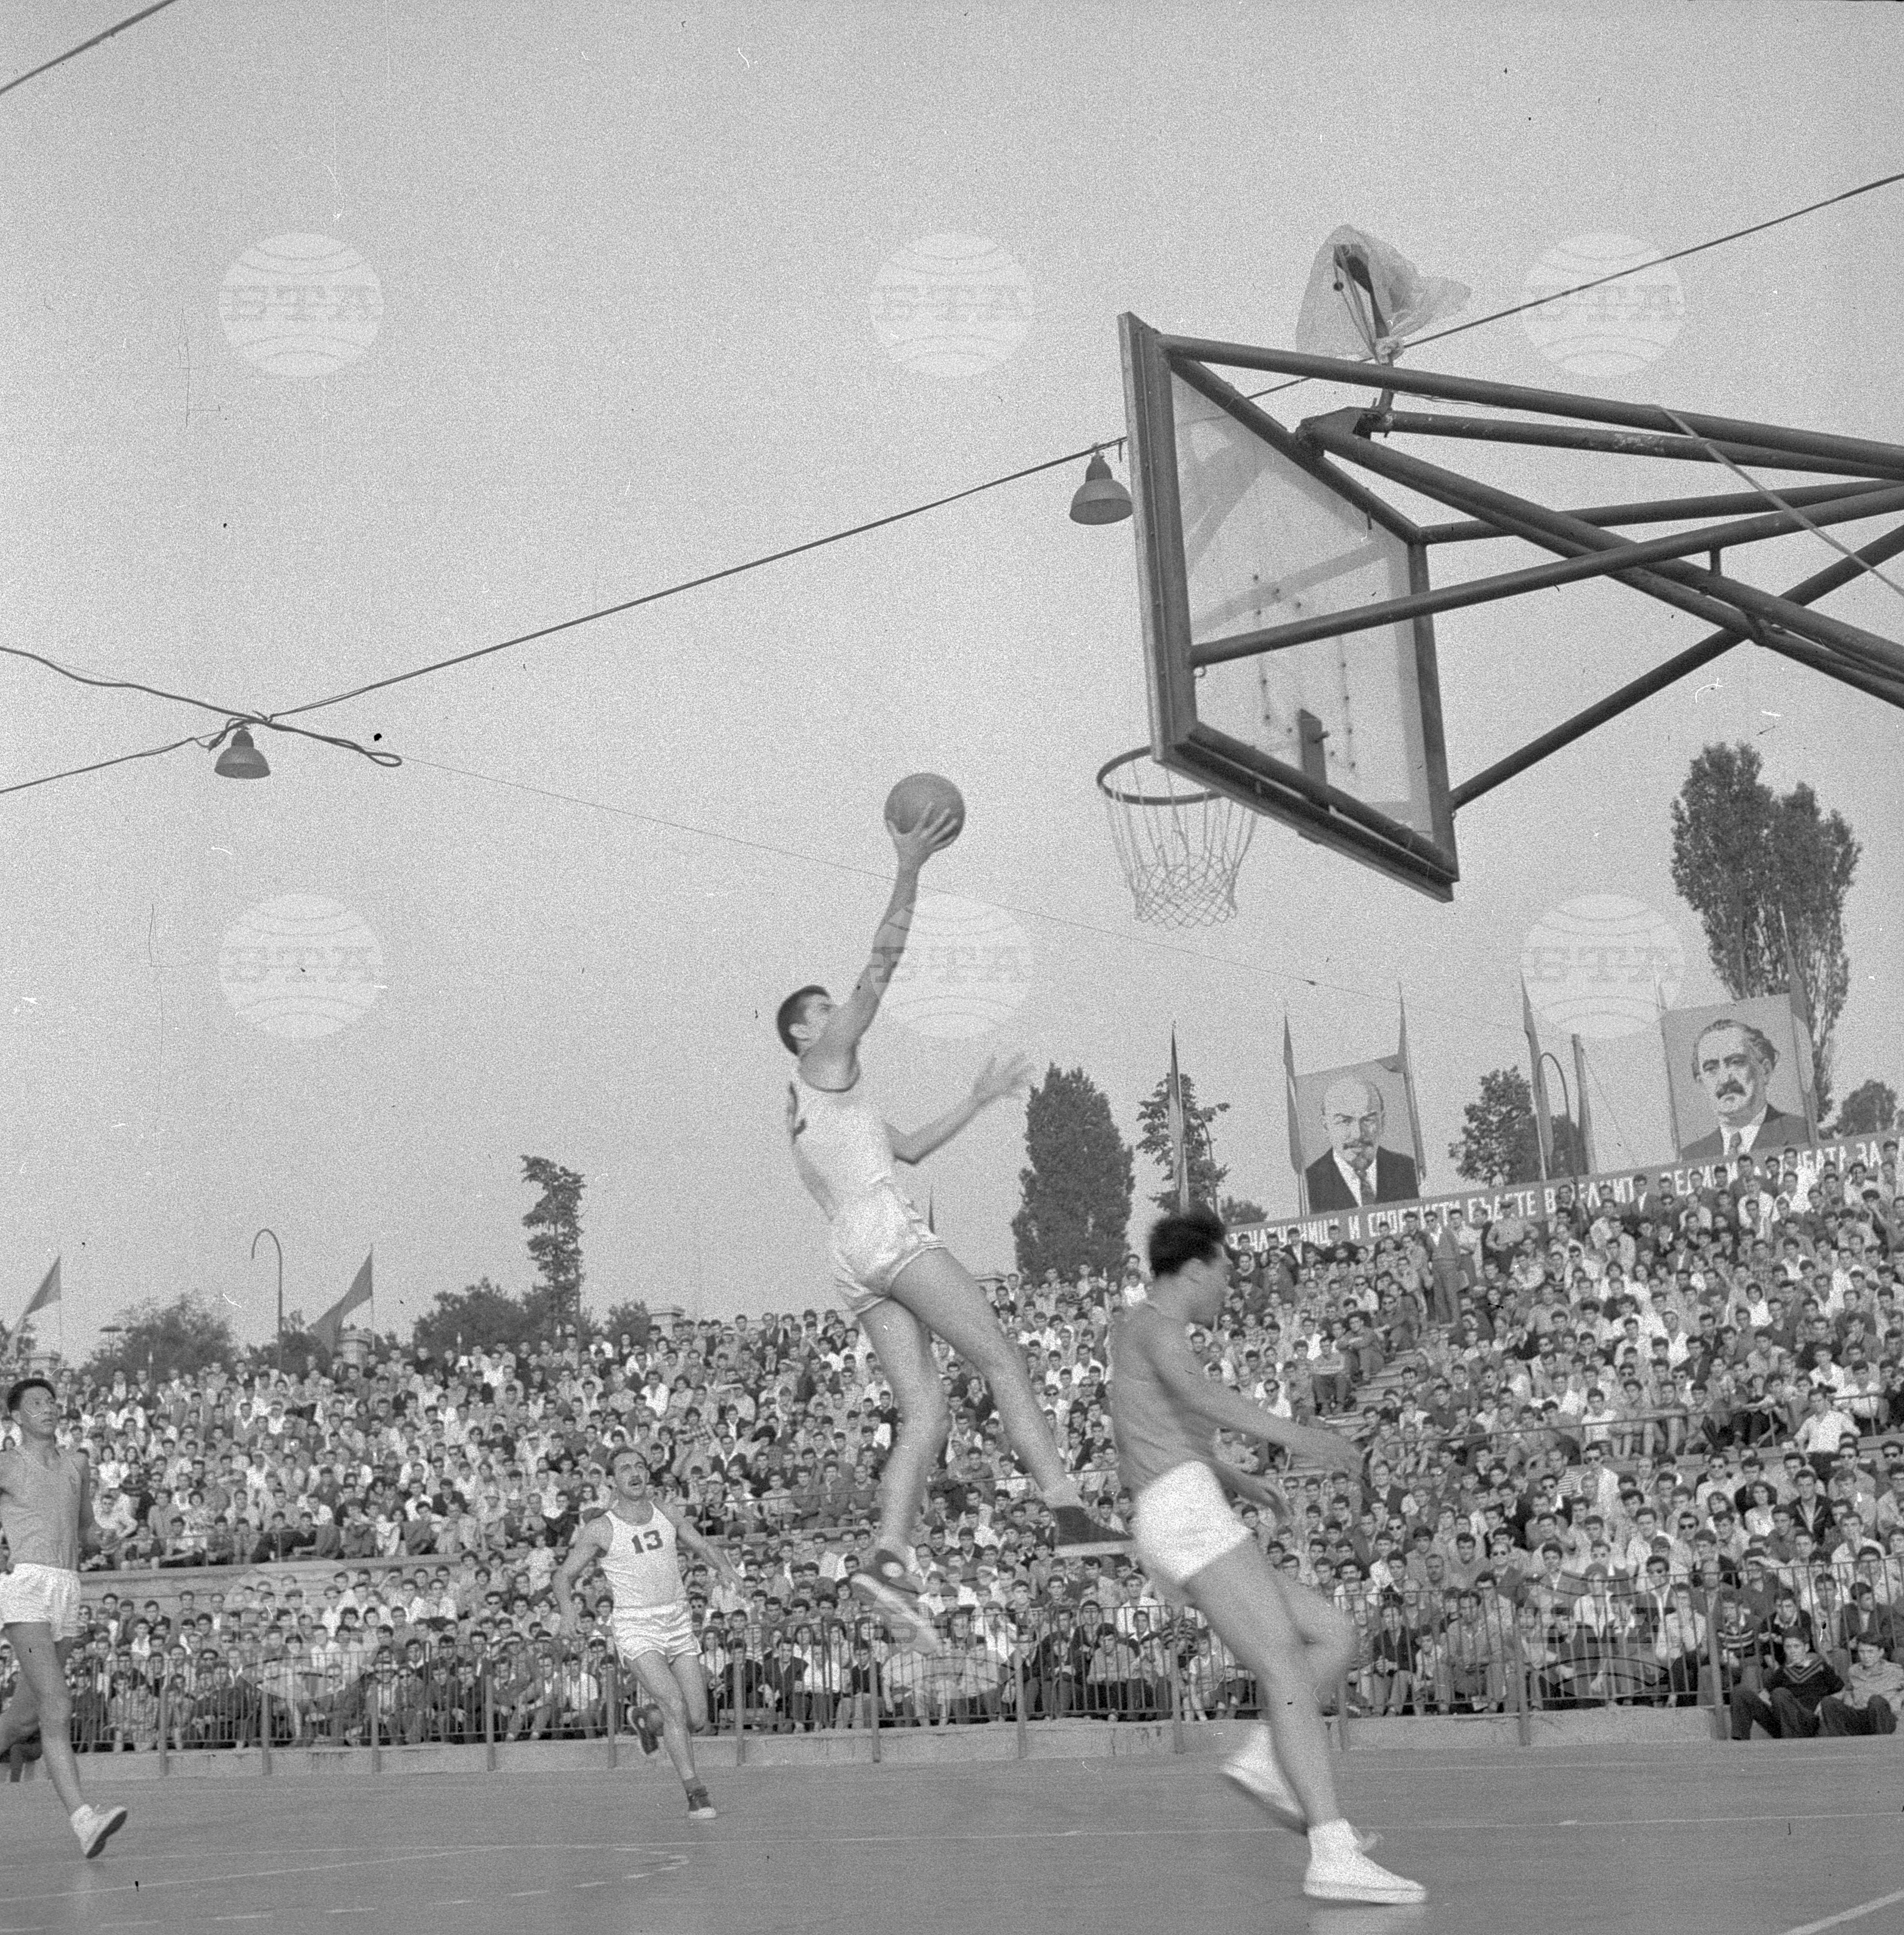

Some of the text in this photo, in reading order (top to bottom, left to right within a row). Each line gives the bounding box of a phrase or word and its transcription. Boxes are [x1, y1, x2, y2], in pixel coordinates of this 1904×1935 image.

[1348, 1214, 1361, 1240] И
[1367, 1200, 1461, 1237] СПОРИТ
[1544, 1187, 1556, 1213] В
[631, 1530, 663, 1554] 13
